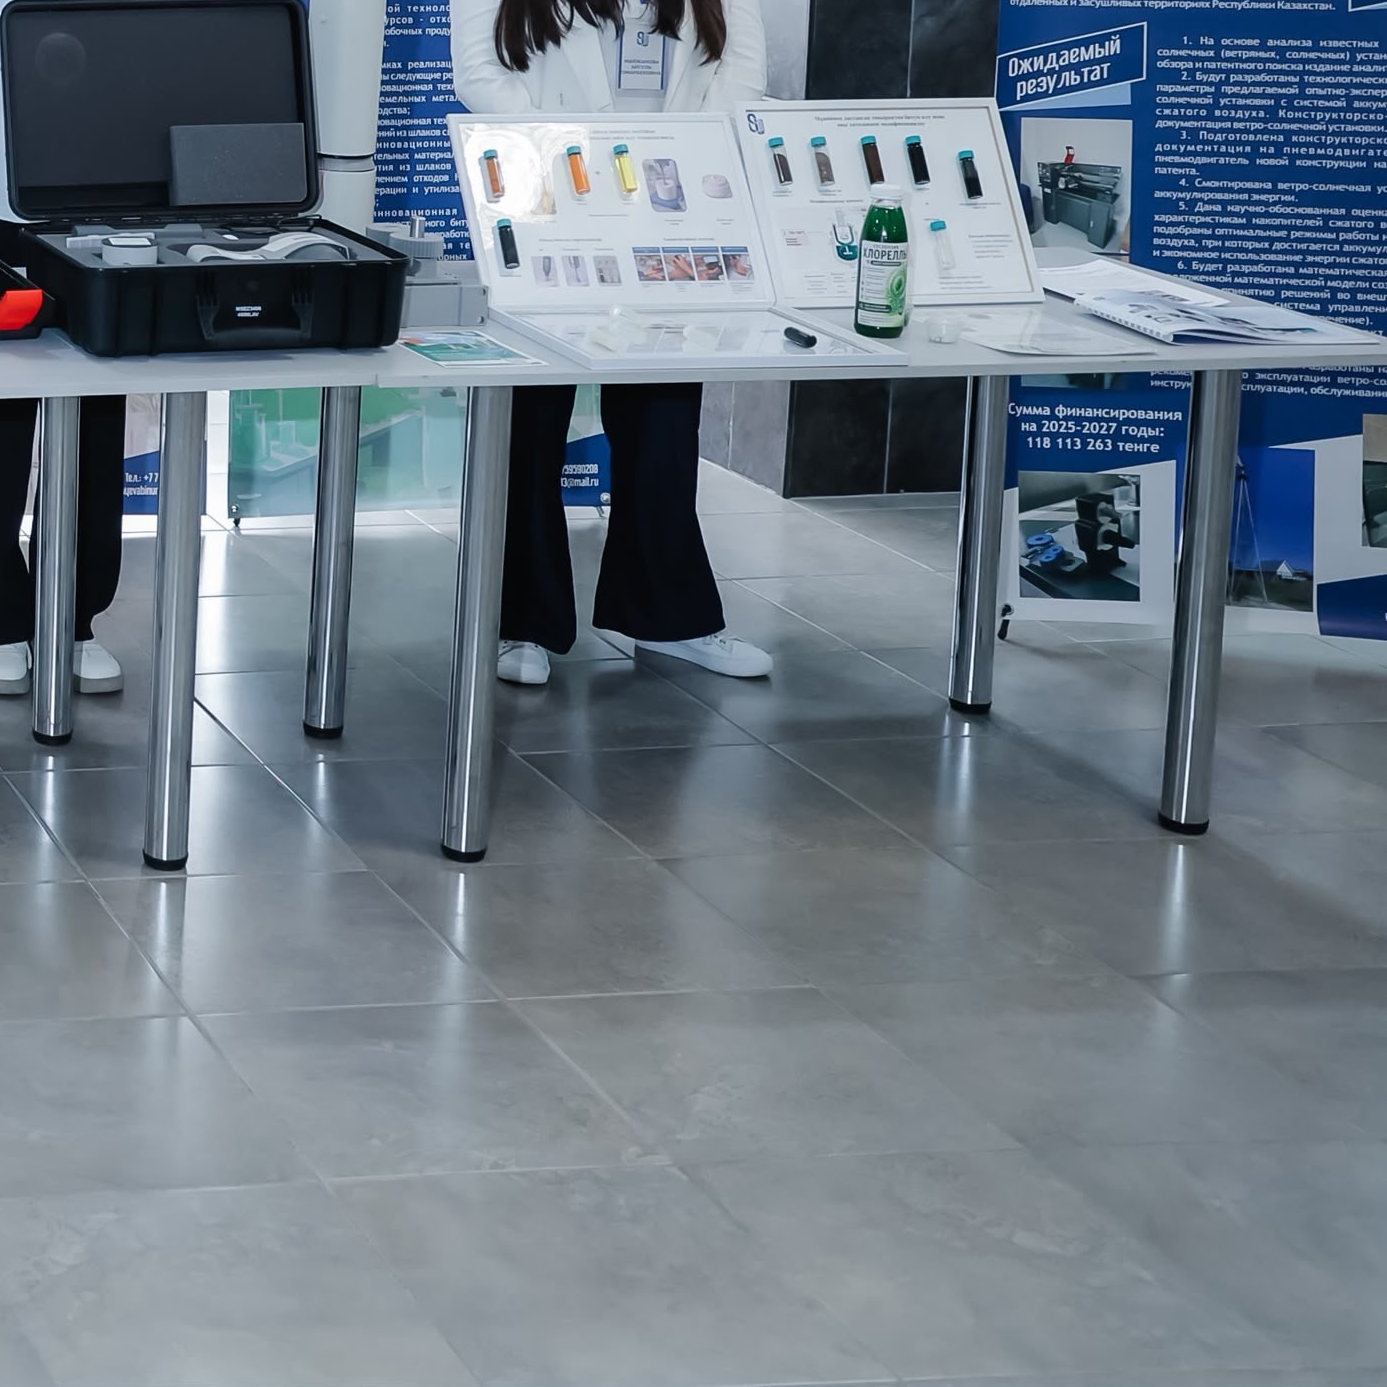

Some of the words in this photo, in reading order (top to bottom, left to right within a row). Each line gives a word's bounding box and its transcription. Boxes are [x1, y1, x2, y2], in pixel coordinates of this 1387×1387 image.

[1008, 38, 1120, 76] Ожидаемый
[1016, 62, 1111, 100] результат
[1008, 403, 1051, 416] Сумма
[1054, 403, 1182, 421] финансирования
[1041, 420, 1117, 434] 2025-2027
[1121, 425, 1164, 438] годы:
[1026, 436, 1051, 448] 118
[1056, 437, 1081, 450] 113
[1086, 438, 1112, 451] 263
[1116, 442, 1159, 452] тенге
